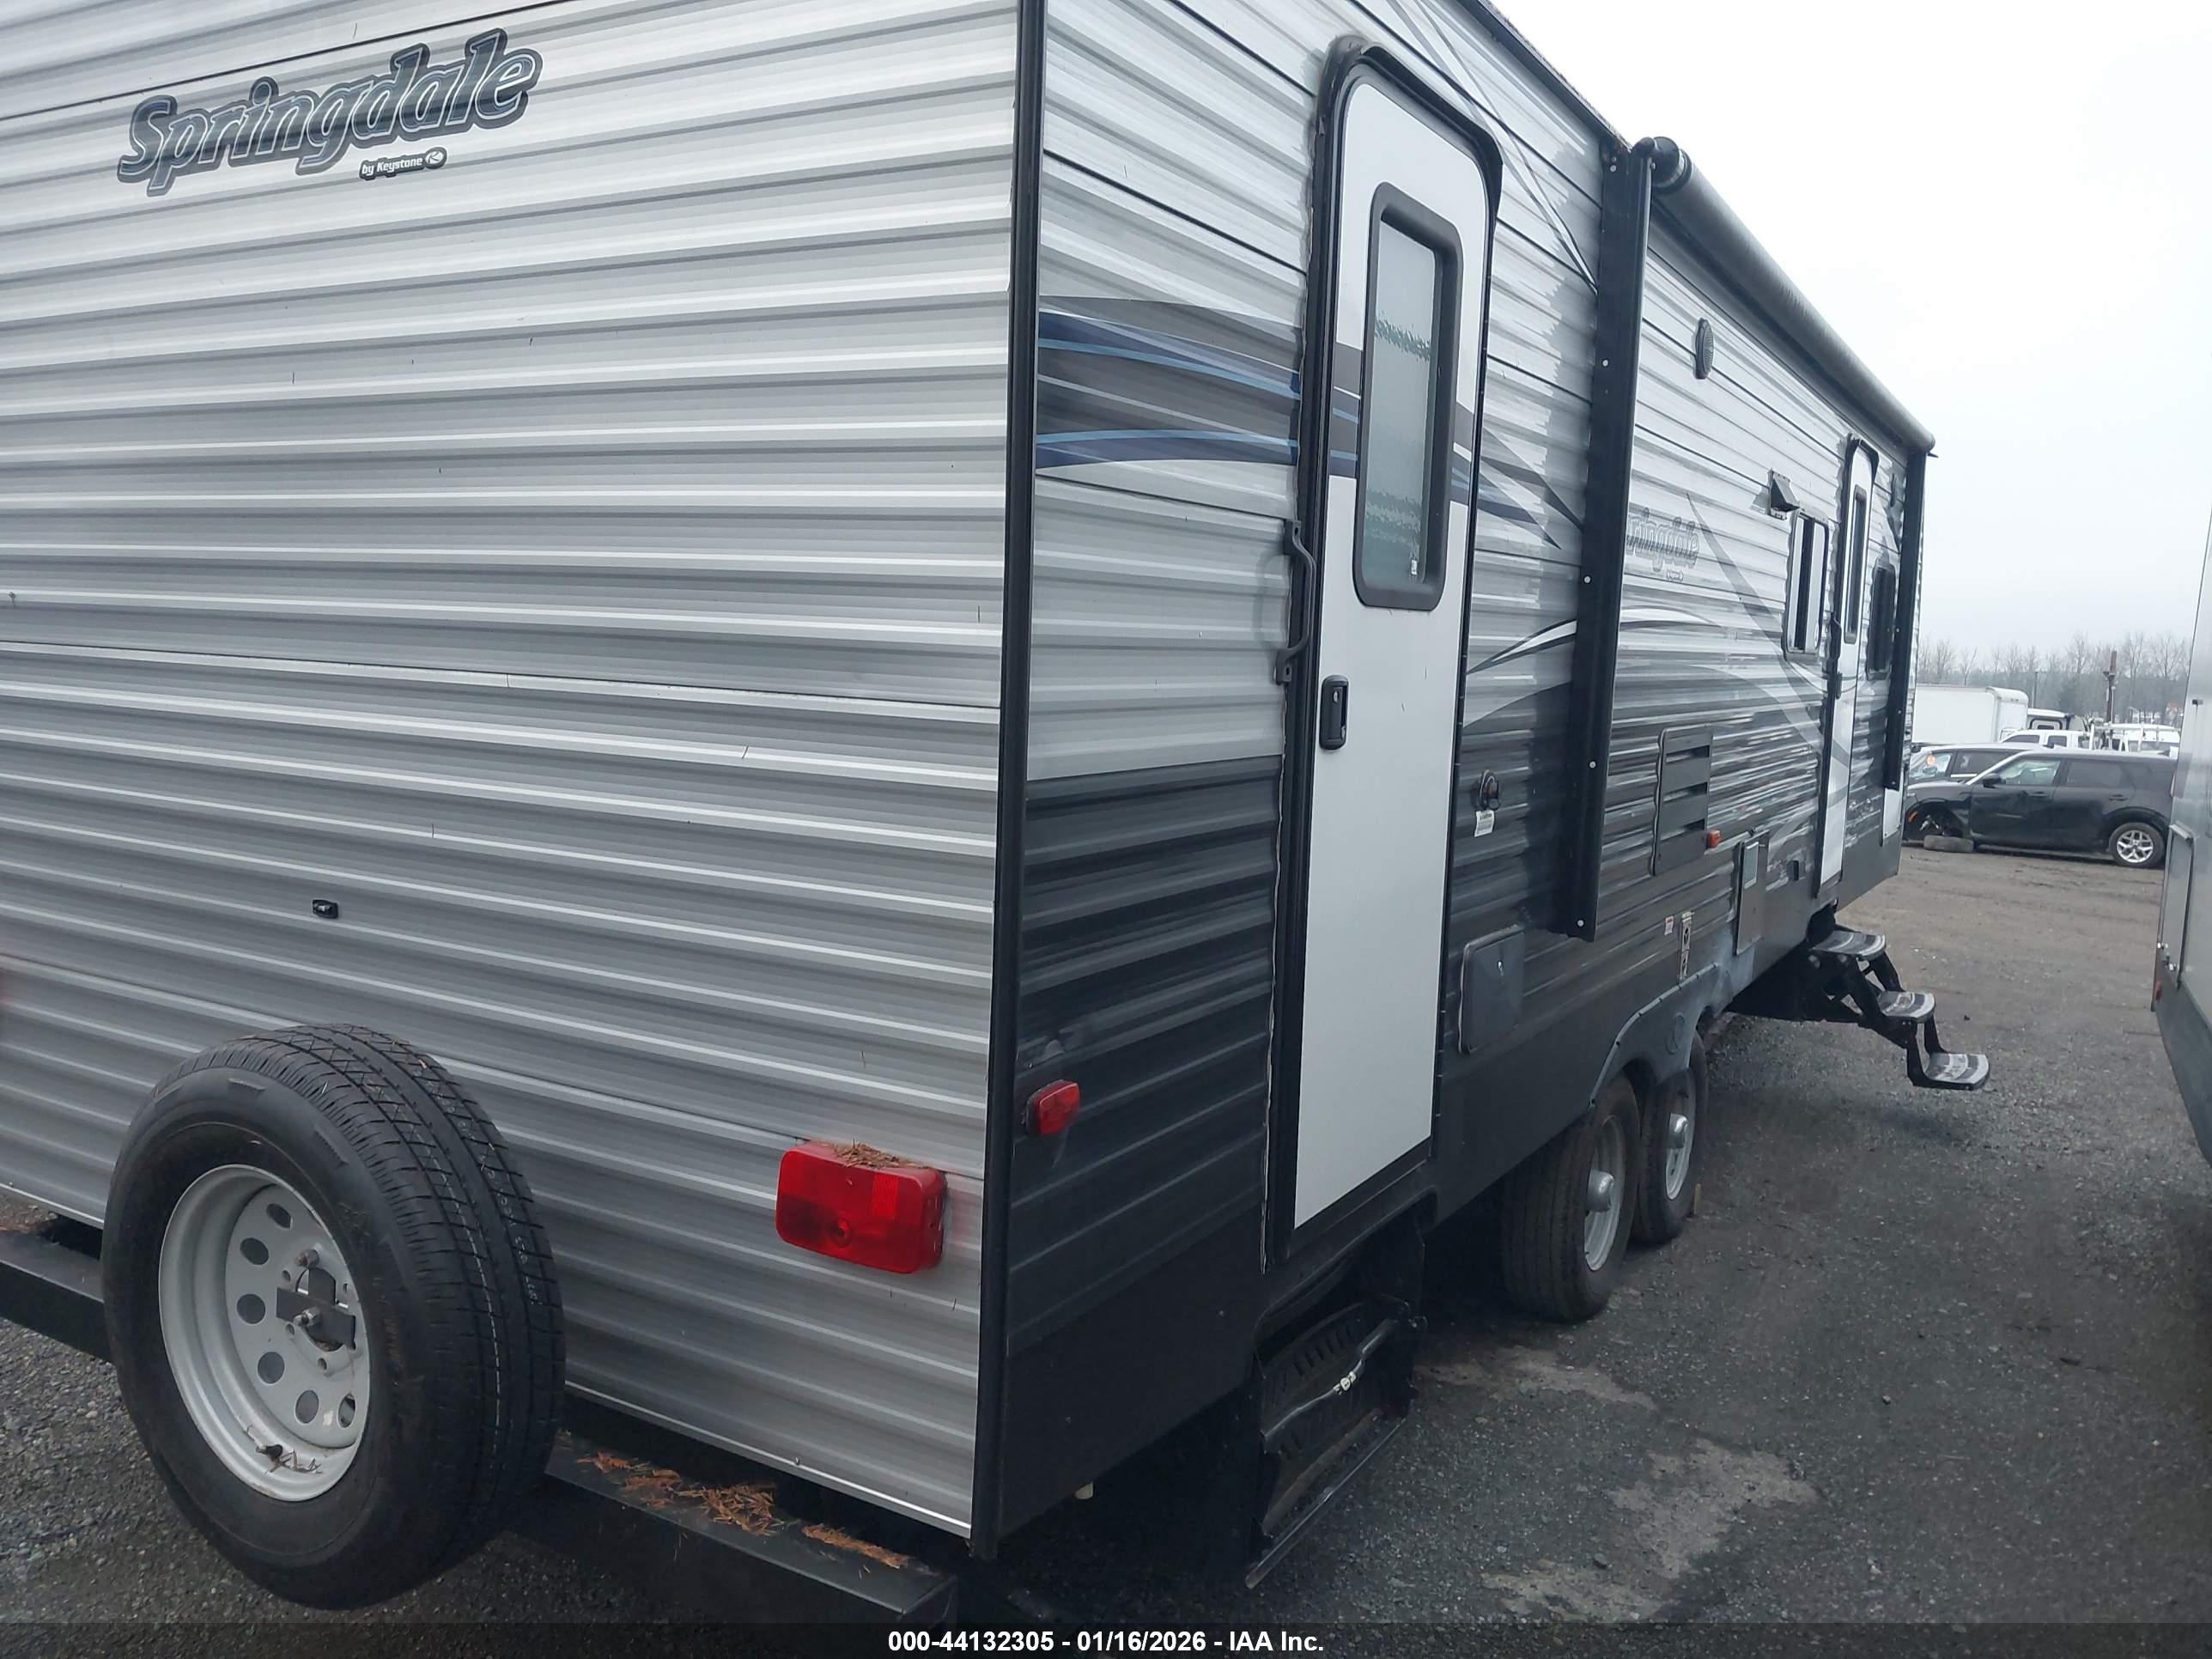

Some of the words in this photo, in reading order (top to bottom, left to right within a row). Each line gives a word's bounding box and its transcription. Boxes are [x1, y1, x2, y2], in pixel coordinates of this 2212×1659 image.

[118, 30, 541, 194] Springdale
[362, 164, 374, 176] by
[376, 157, 423, 173] Keystone
